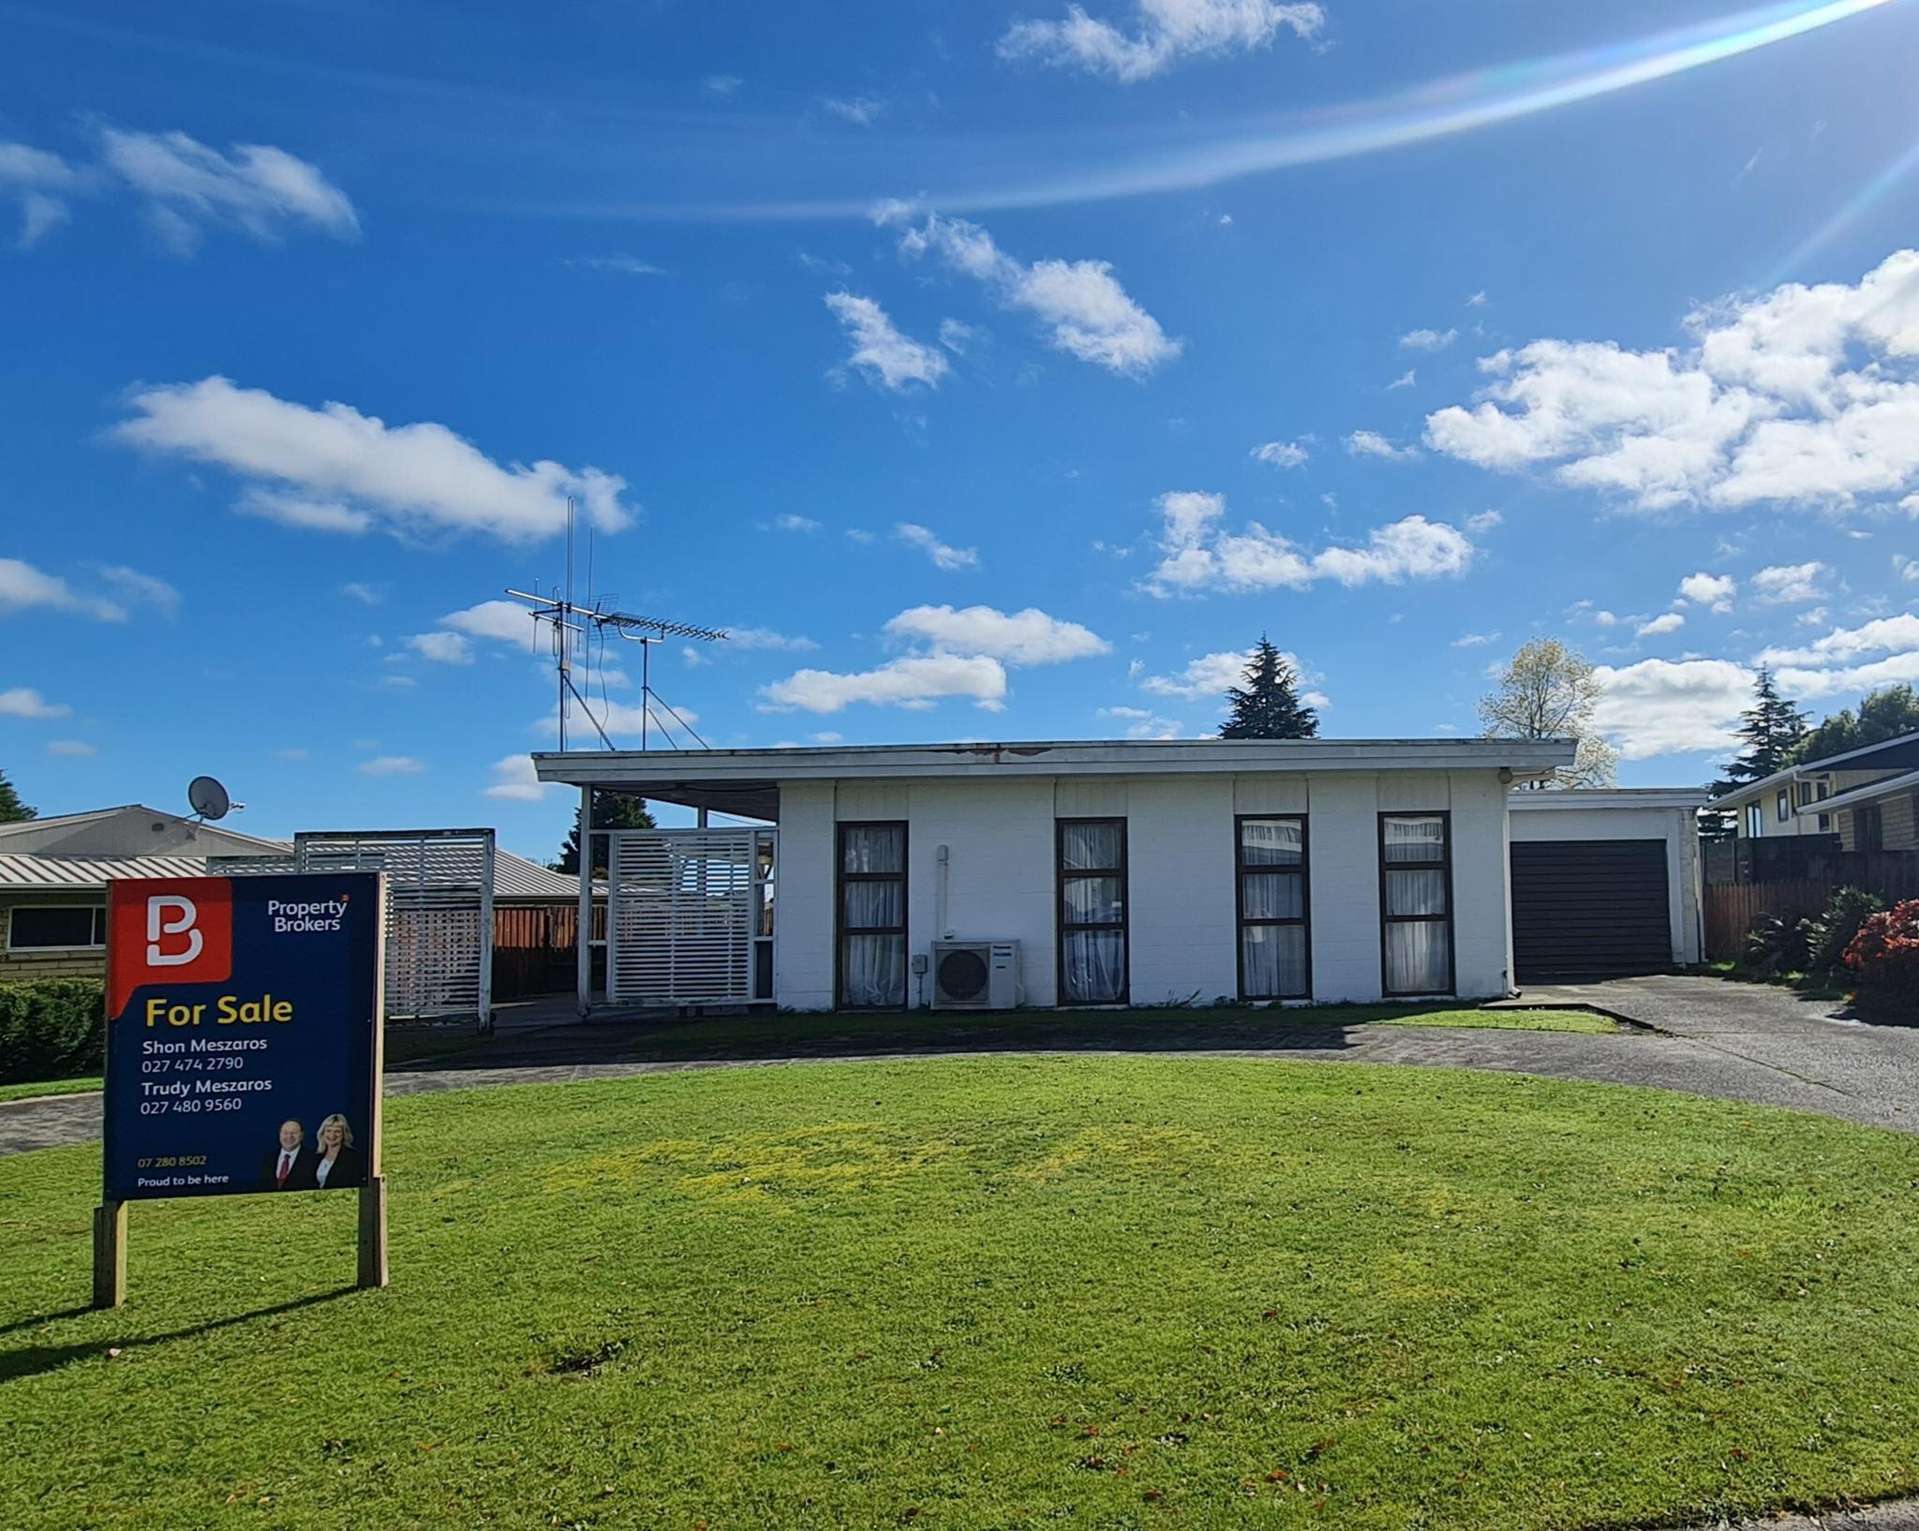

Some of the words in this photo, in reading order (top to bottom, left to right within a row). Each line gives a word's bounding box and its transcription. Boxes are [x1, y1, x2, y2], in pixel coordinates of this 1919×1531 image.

[268, 900, 347, 917] Property
[275, 917, 340, 932] Brokers
[146, 998, 206, 1027] For
[217, 994, 293, 1024] Sale
[142, 1040, 185, 1055] Shon
[191, 1037, 268, 1053] Meszaros
[142, 1060, 169, 1073] 027
[174, 1059, 202, 1071] 474
[207, 1057, 244, 1069] 2790
[141, 1081, 191, 1097] Trudy
[195, 1077, 273, 1093] Meszaros
[140, 1102, 168, 1115] 027
[173, 1100, 201, 1113] 480
[206, 1098, 242, 1111] 9560
[137, 1158, 151, 1168] 07
[155, 1157, 176, 1167] 280
[178, 1156, 207, 1166] 8502
[137, 1176, 170, 1188] Proud
[173, 1176, 184, 1186] to
[187, 1175, 202, 1185] be
[204, 1174, 229, 1184] here
